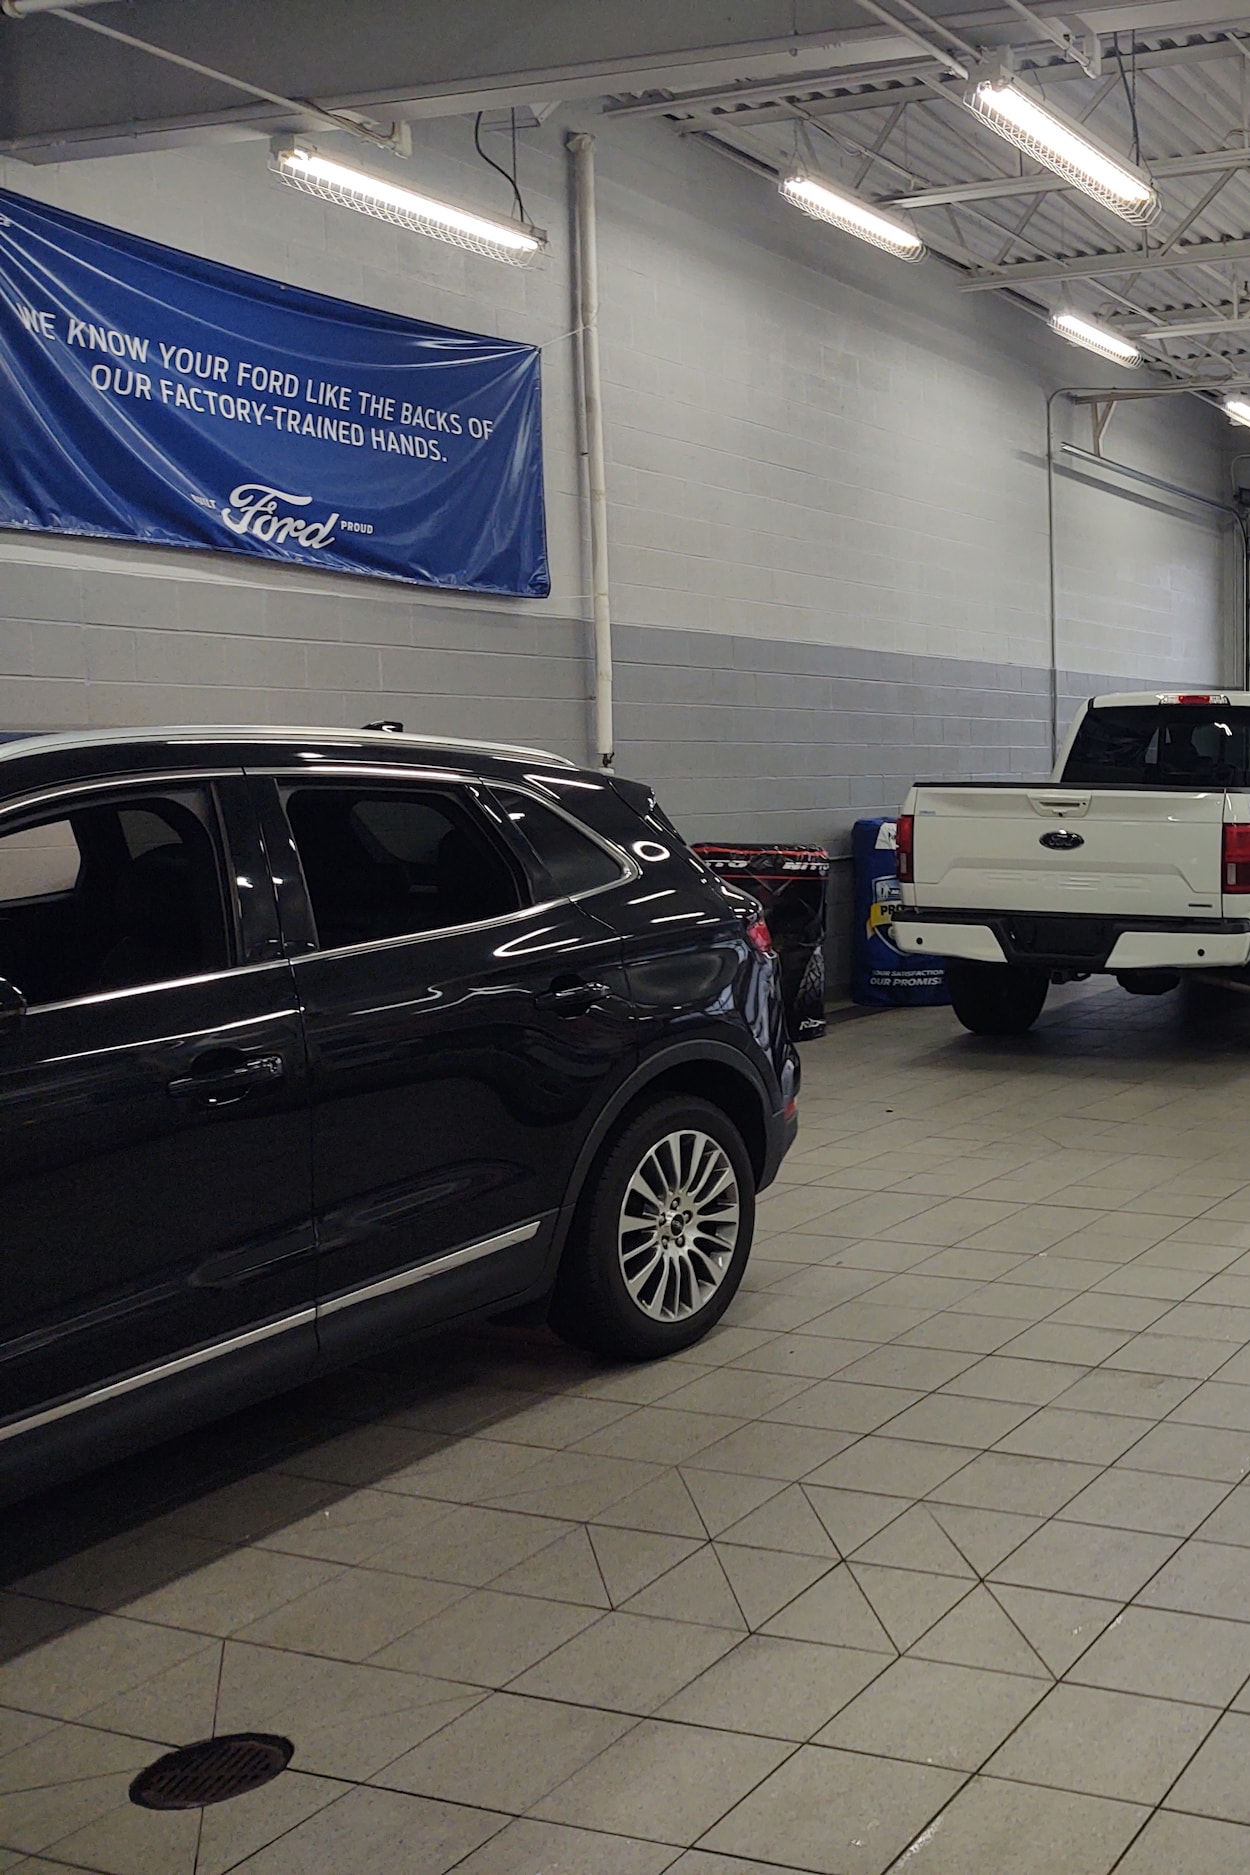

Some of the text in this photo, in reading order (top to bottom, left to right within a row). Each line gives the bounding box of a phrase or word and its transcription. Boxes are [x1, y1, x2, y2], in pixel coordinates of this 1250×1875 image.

[16, 303, 494, 440] WE KNOW YOUR FORD LIKE THE BACKS OF
[90, 364, 448, 462] OUR FACTORY-TRAINED HANDS.
[221, 484, 340, 549] Ford
[340, 520, 374, 534] PROUD
[704, 859, 748, 868] TTO
[870, 977, 892, 986] OUR
[891, 969, 945, 977] SATISFACTION
